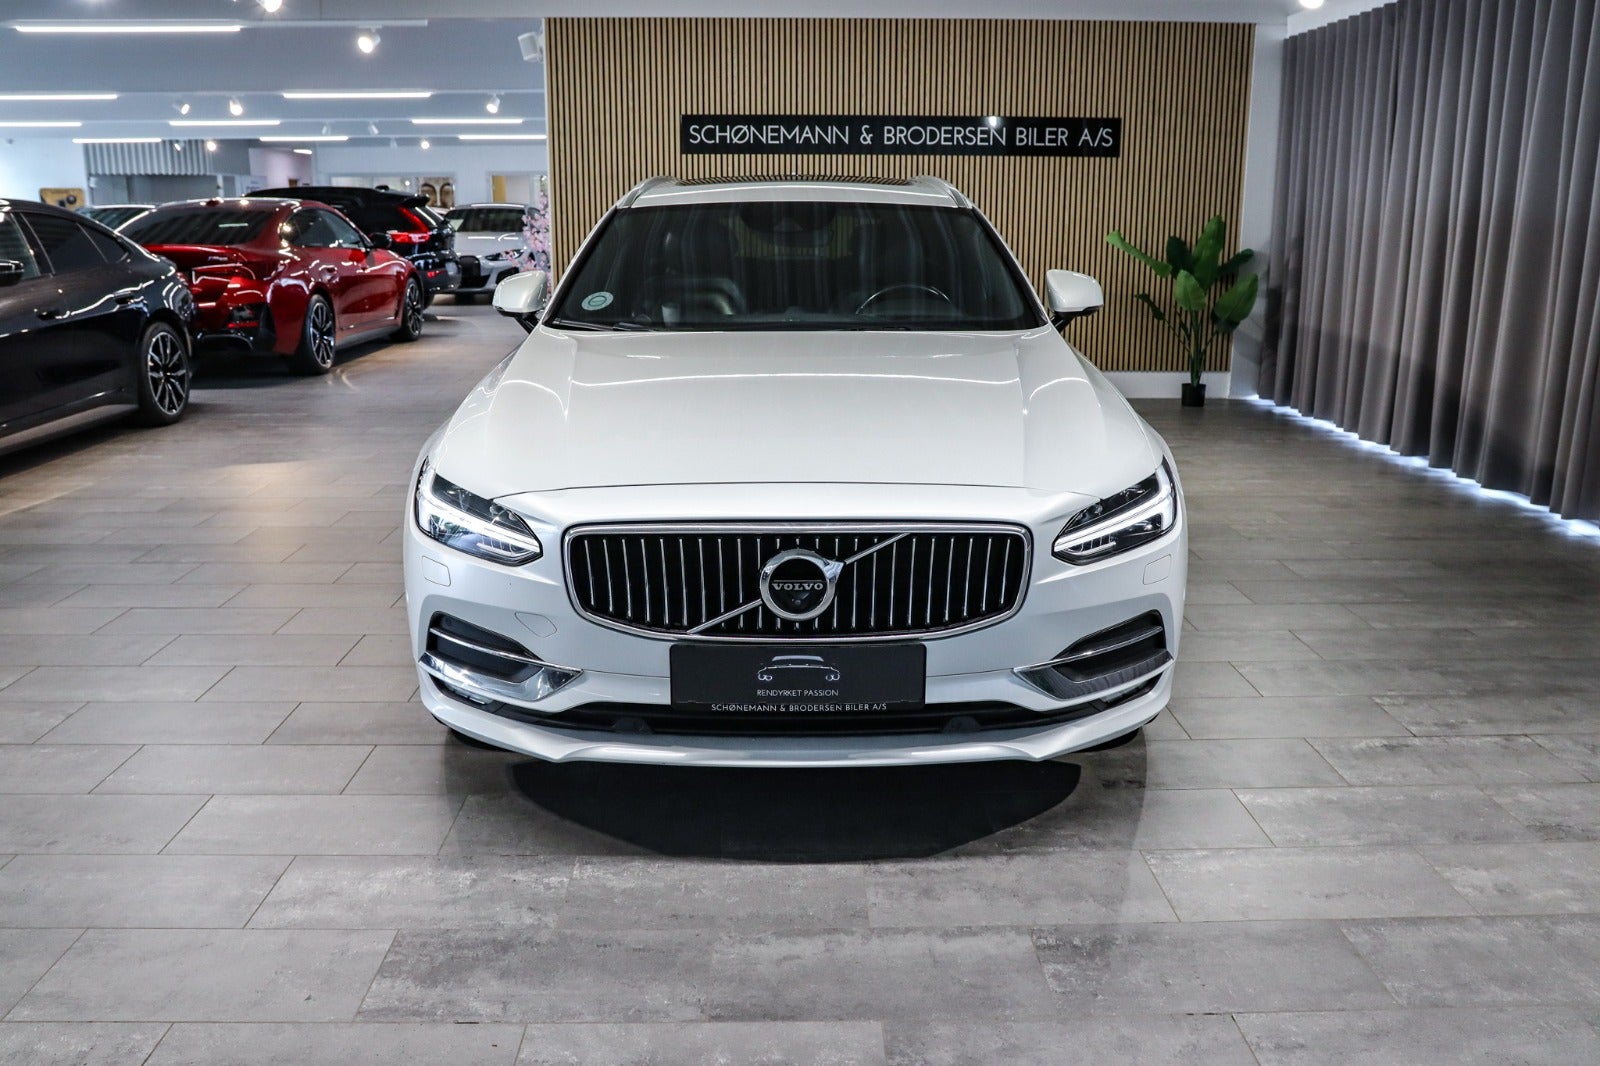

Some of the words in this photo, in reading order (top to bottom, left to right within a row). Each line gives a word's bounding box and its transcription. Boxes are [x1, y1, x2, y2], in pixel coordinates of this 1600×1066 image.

[689, 125, 848, 144] SCHØNEMANN
[859, 126, 874, 143] &
[884, 125, 1006, 147] BRODERSEN
[1015, 127, 1068, 147] BILER
[1078, 129, 1113, 148] A/S
[771, 582, 823, 591] VOLVO
[757, 689, 802, 697] RENDYRKET
[804, 689, 839, 697] PASSION
[711, 703, 777, 712] SCHØNEMANN
[780, 704, 786, 712] &
[789, 704, 842, 712] BRODERSEN
[845, 703, 869, 711] BILER
